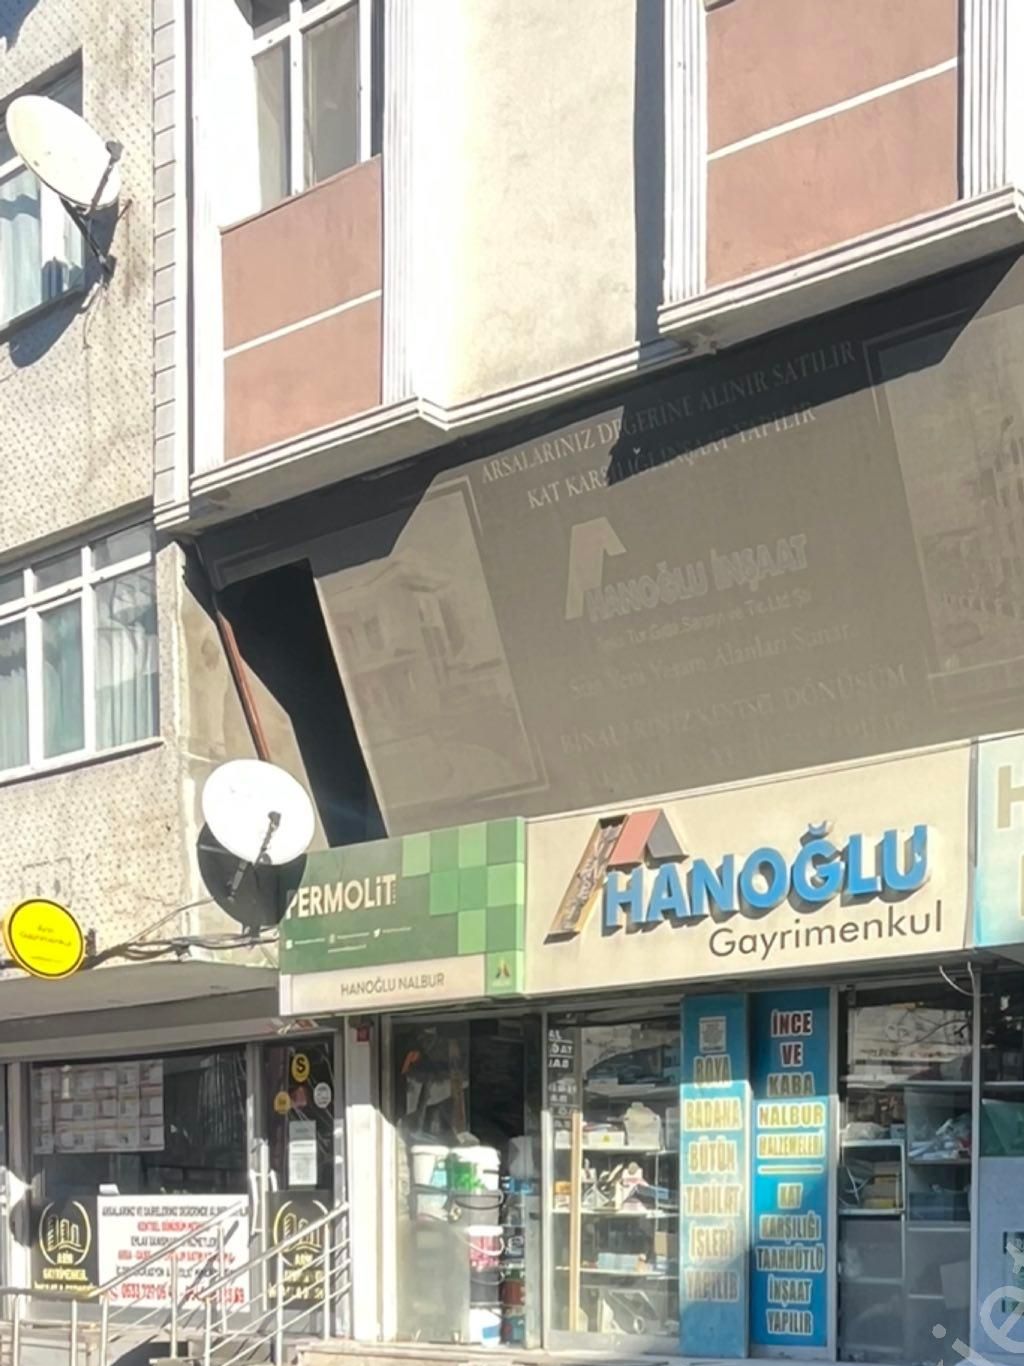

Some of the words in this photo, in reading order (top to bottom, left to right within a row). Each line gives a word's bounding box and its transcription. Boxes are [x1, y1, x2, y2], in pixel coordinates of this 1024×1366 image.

[481, 427, 596, 484] ARSALARINIZ
[526, 481, 560, 510] KAT
[604, 818, 929, 930] HANOĞLU
[708, 900, 942, 961] Gayrimenkul
[340, 975, 397, 997] HANOĞLU
[398, 972, 445, 992] NALBUR
[771, 1009, 812, 1037] İNCE
[780, 1041, 803, 1068] VE
[767, 1072, 815, 1097] KABA
[757, 1102, 825, 1129] NALBUR
[768, 1274, 812, 1307] İNŞAAT
[766, 1309, 813, 1336] YAPILIR
